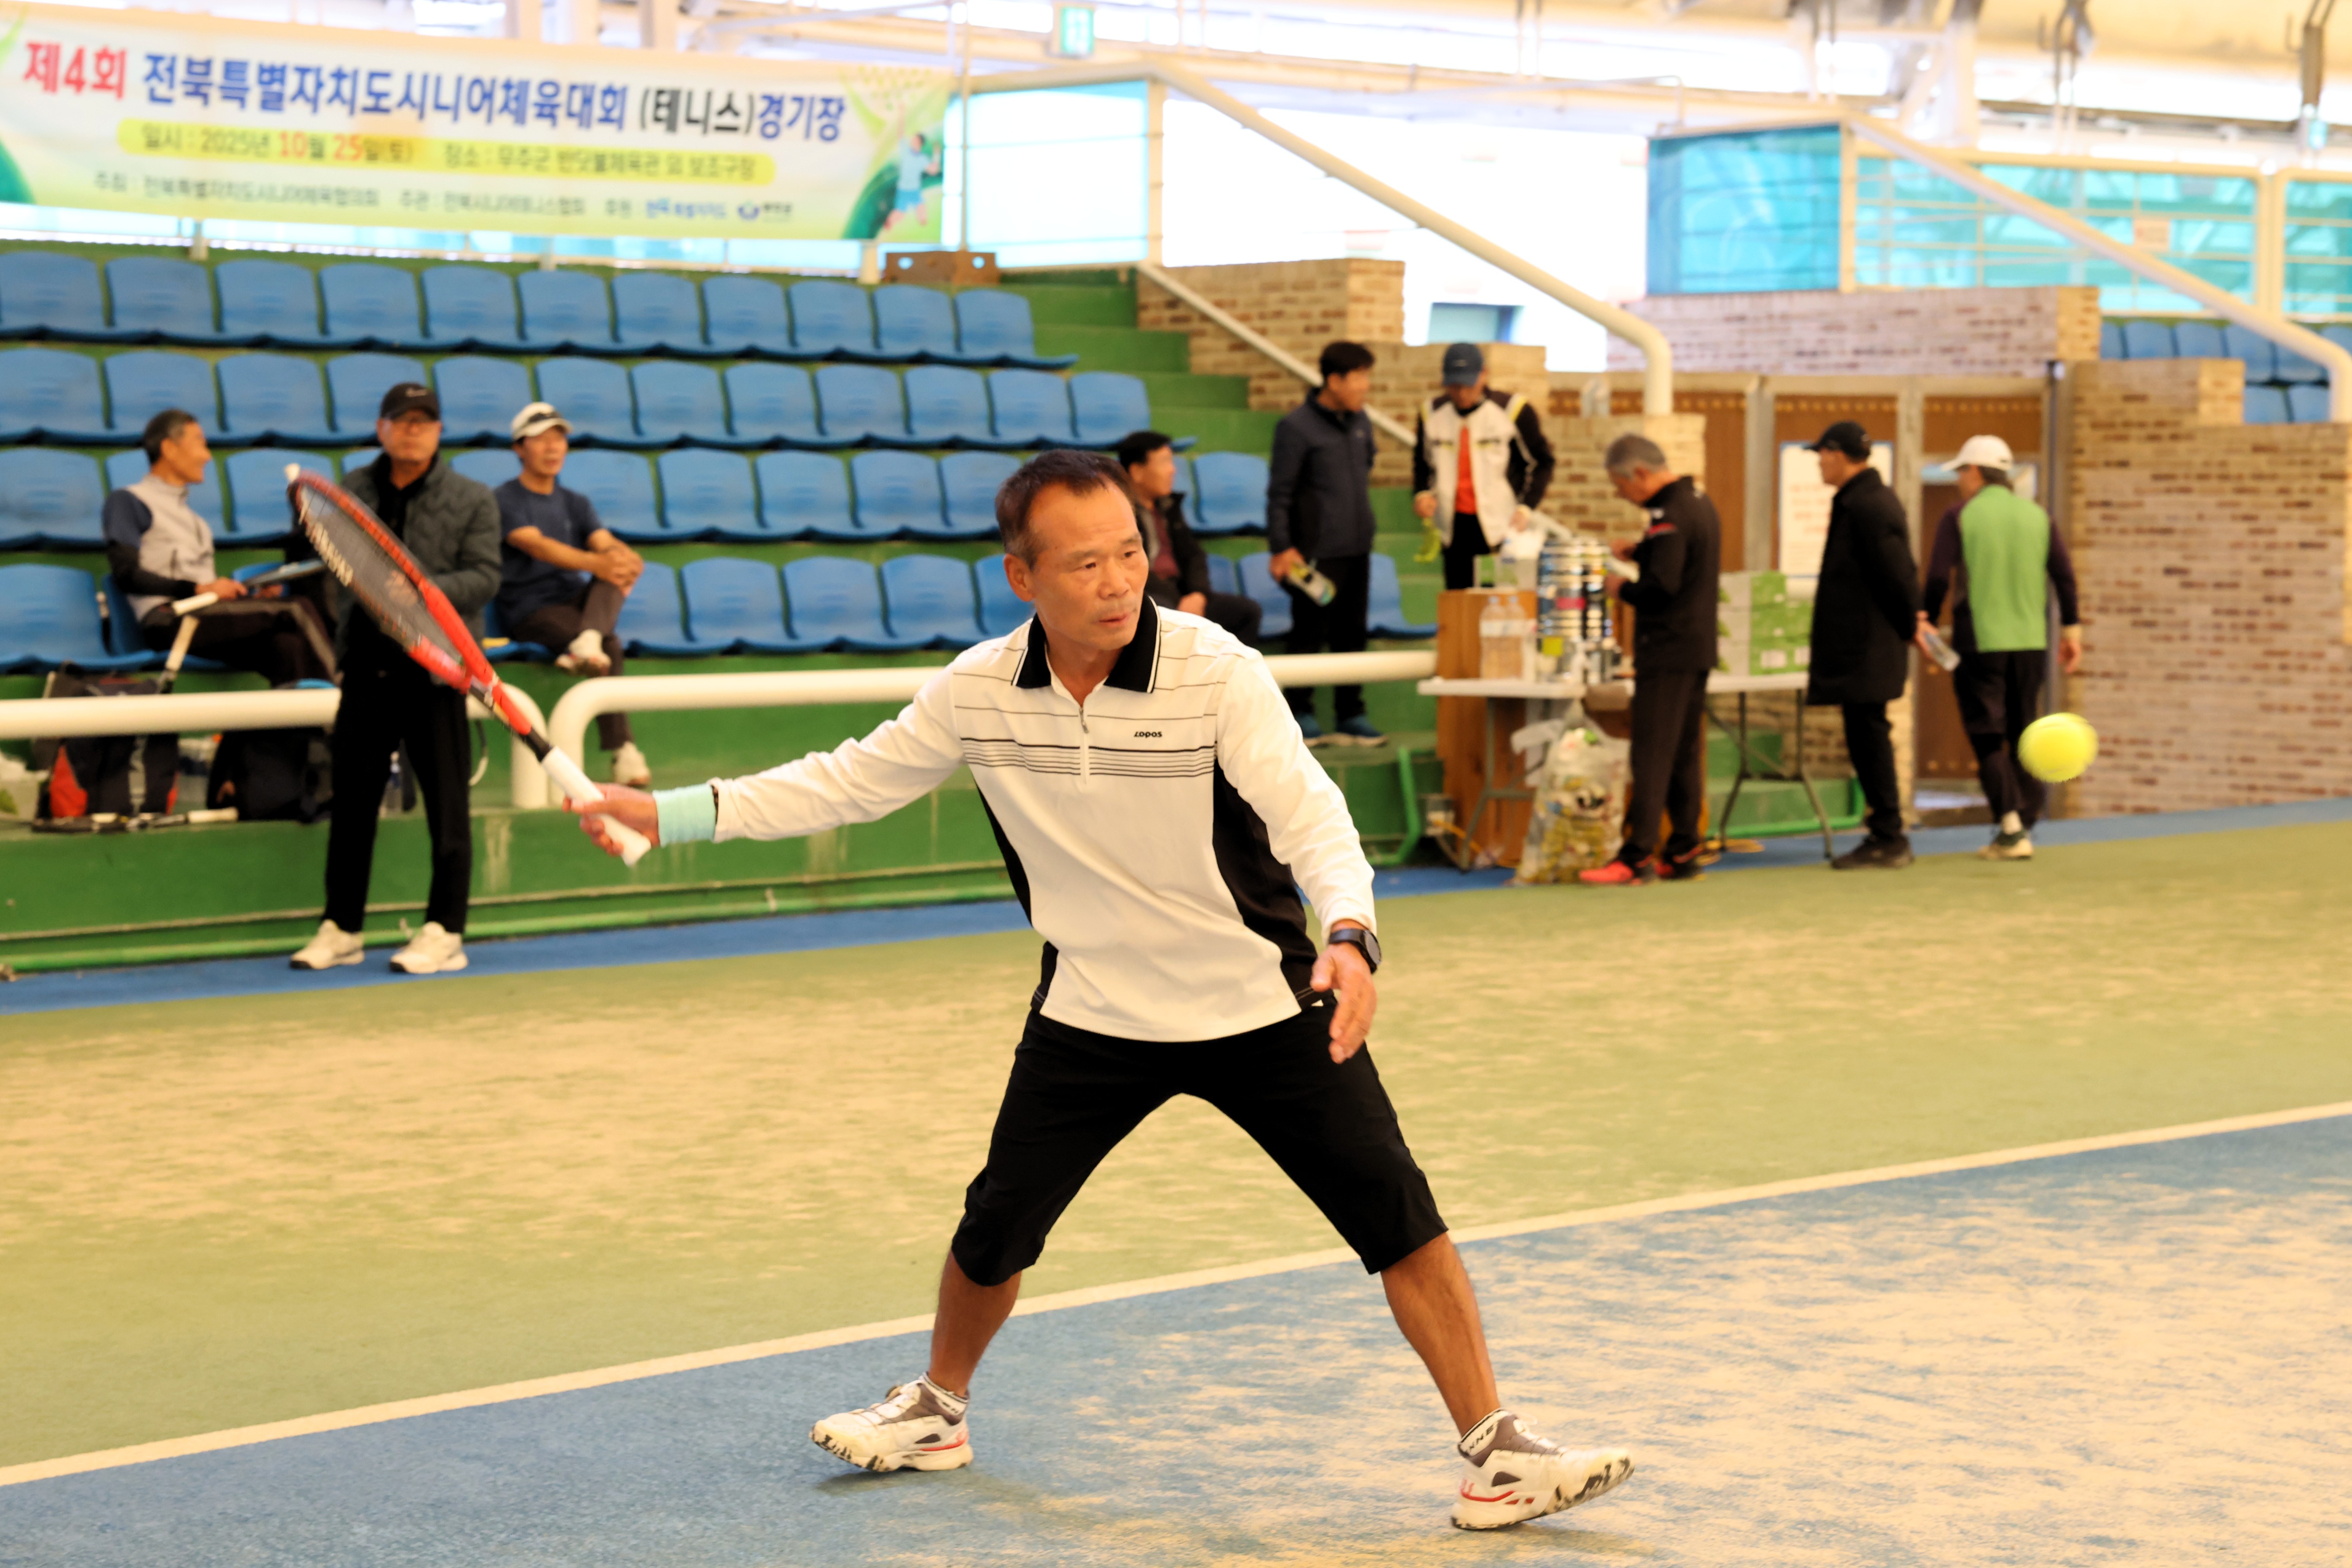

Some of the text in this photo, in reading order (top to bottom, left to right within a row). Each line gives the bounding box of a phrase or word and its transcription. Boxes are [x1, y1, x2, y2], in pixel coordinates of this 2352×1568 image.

[22, 41, 846, 142] 제4회 전북특별자치도시니어체육대회 (테니스)경기장
[142, 122, 182, 150] 일시
[201, 128, 270, 158] 2025년
[279, 131, 325, 160] 10월
[333, 134, 413, 164] 25일(토)
